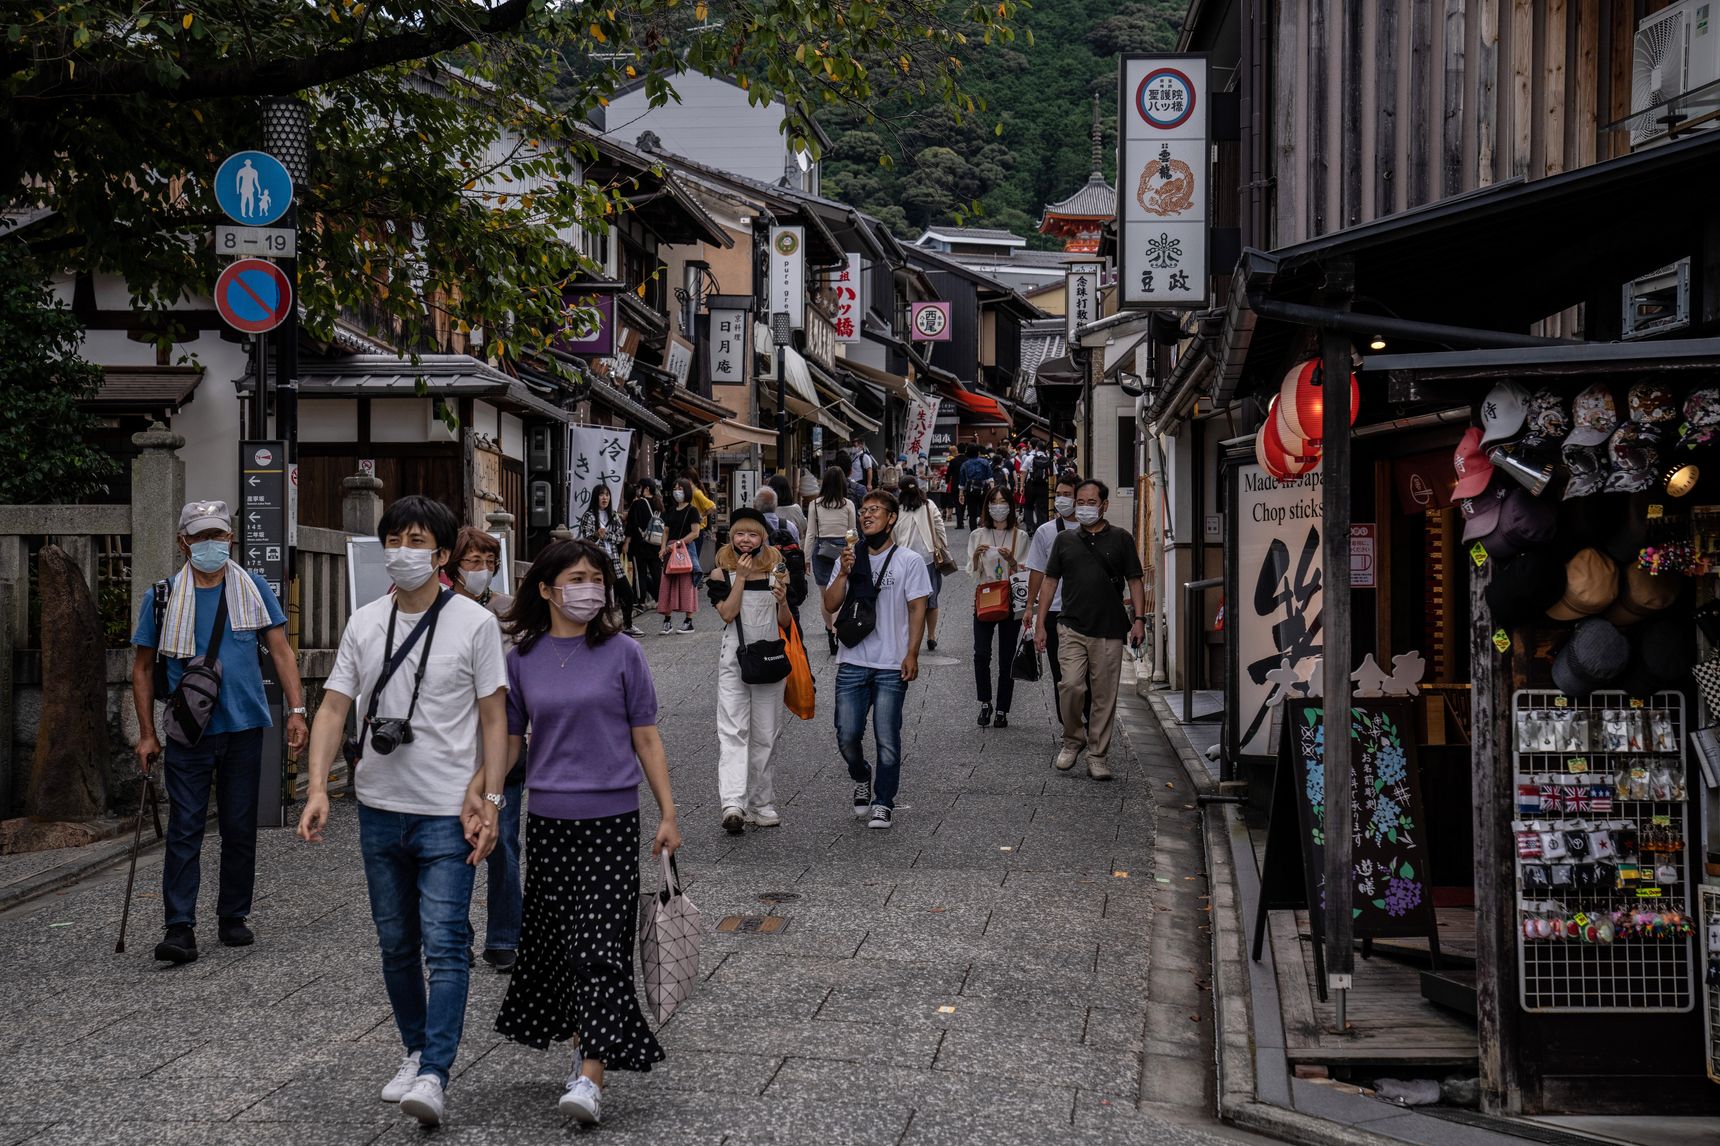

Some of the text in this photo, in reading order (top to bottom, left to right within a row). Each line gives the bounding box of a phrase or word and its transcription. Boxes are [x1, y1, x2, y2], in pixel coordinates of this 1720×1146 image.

[1148, 90, 1183, 101] 聖護院
[1141, 270, 1191, 292] 豆政
[733, 314, 742, 342] 京料理
[925, 311, 937, 332] 西尾
[716, 321, 733, 374] 日月庵
[1244, 473, 1279, 492] Made
[1252, 498, 1324, 525] Chop sticks
